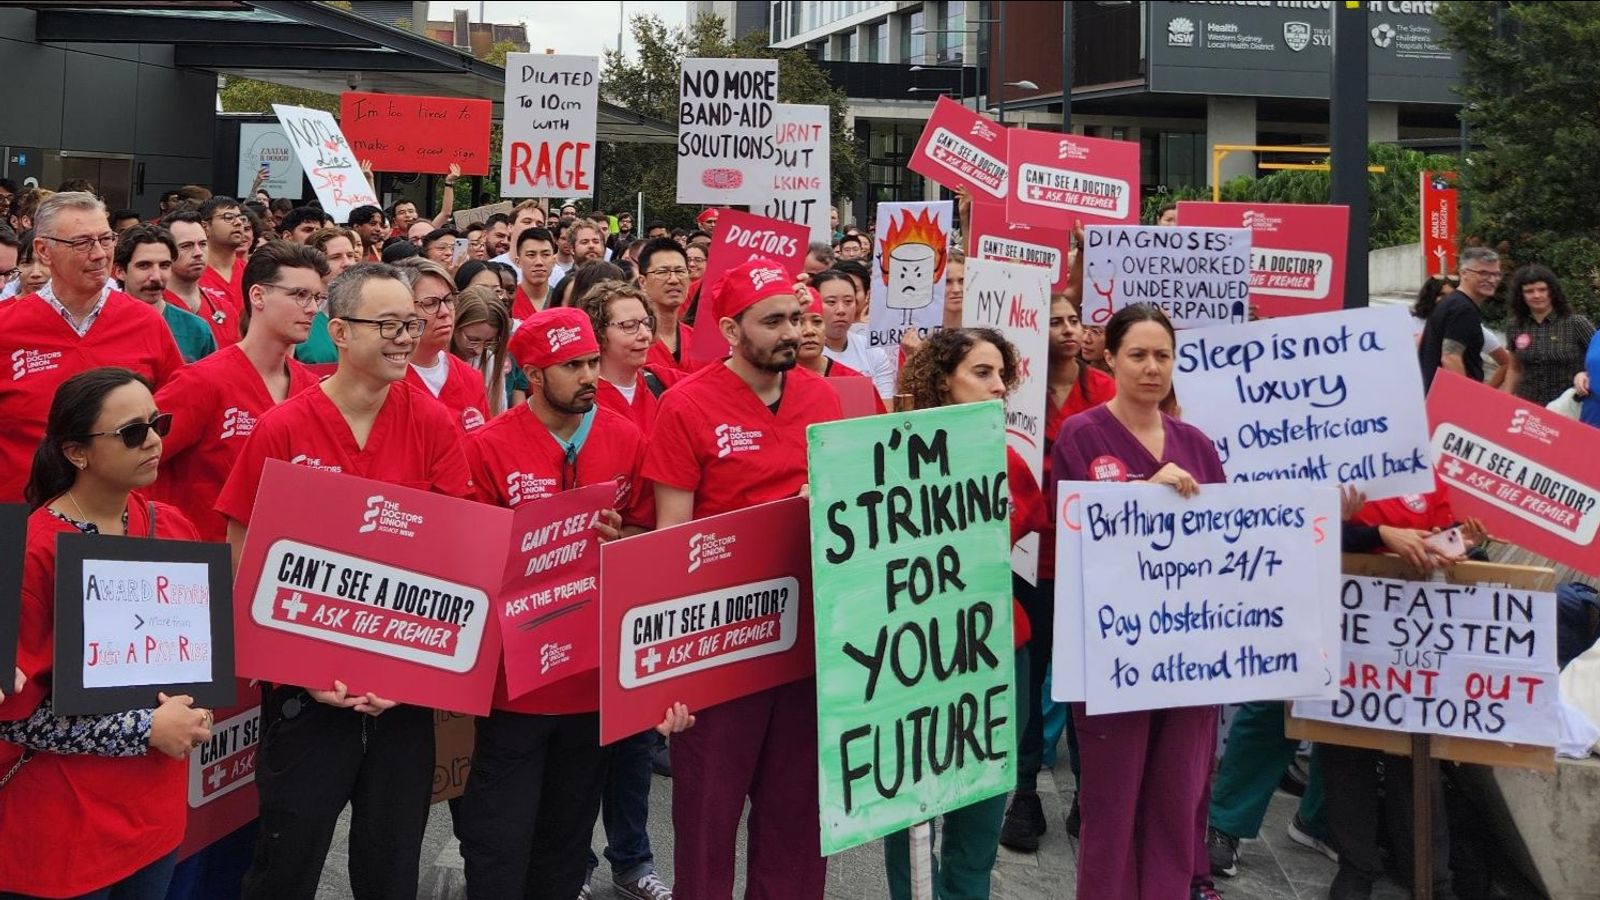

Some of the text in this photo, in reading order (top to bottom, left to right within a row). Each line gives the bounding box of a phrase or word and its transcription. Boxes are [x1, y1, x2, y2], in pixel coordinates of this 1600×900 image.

[1169, 33, 1194, 43] NSW
[1208, 23, 1238, 33] Health
[1208, 34, 1263, 44] Western Sydney
[522, 65, 593, 86] DILATED
[683, 69, 776, 101] NO MORE
[533, 119, 569, 130] WITH
[680, 102, 772, 128] BAND-AID
[678, 131, 774, 159] SOLUTIONS
[775, 122, 823, 144] URNT
[509, 141, 590, 190] RAGE
[957, 145, 971, 160] SEE
[1026, 169, 1123, 199] CAN'T SEE A DOCTOR?
[1046, 191, 1114, 209] ASK THE PREMIER
[725, 224, 798, 257] DOCTORS
[983, 240, 1056, 264] CAN'T SEE A DOCTOR?
[1089, 230, 1233, 251] DIAGNOSES:
[1122, 256, 1246, 275] OVERWORKED
[1259, 254, 1267, 270] A
[1271, 256, 1323, 275] DOCTOR?
[1123, 280, 1249, 300] UNDERVALUED
[1267, 274, 1311, 288] PREMIER
[977, 290, 1006, 325] MY
[26, 351, 62, 363] DOCTORS
[1177, 325, 1386, 374] Sleep is not a
[1235, 373, 1347, 408] luxury
[730, 431, 762, 440] DOCTORS
[1238, 415, 1388, 449] Obstetricians
[873, 427, 951, 487] I'M
[1381, 447, 1428, 478] back
[521, 479, 557, 488] DOCTORS
[1442, 432, 1597, 516] CAN'T SEE A DOCTOR?
[521, 486, 545, 494] UNION
[1465, 470, 1577, 527] ASK THE PREMIER
[381, 508, 424, 524] DOCTORS
[384, 501, 399, 511] THE
[825, 471, 1008, 565] STRIKING
[379, 517, 408, 529] UNION
[520, 520, 563, 552] CAN'T
[562, 512, 589, 537] SEE
[702, 532, 716, 542] THE
[1086, 499, 1305, 551] Birthing emergencies
[702, 534, 737, 550] DOCTORS
[702, 546, 726, 558] UNION
[524, 539, 588, 577] DOCTOR?
[1137, 545, 1283, 590] happen 24/7
[277, 552, 475, 628] CAN'T SEE A DOCTOR?
[885, 544, 967, 614] FOR
[505, 576, 598, 617] ASK THE PREMIER
[1493, 591, 1533, 624] IN
[311, 603, 454, 649] ASK THE PREMIER
[633, 587, 789, 645] CAN'T SEE A DOCTOR?
[1098, 600, 1284, 646] Pay obstetricians
[126, 642, 138, 664] A
[666, 620, 775, 665] ASK THE PREMIER
[841, 600, 999, 703] YOUR
[1388, 617, 1536, 658] SYSTEM
[1110, 645, 1298, 688] to attend them
[1391, 648, 1449, 670] JUST
[1465, 672, 1544, 705] OUT
[1331, 689, 1507, 734] DOCTORS
[200, 716, 259, 765] CAN'T SE
[839, 683, 1010, 816] FUTURE
[231, 751, 256, 779] ASK
